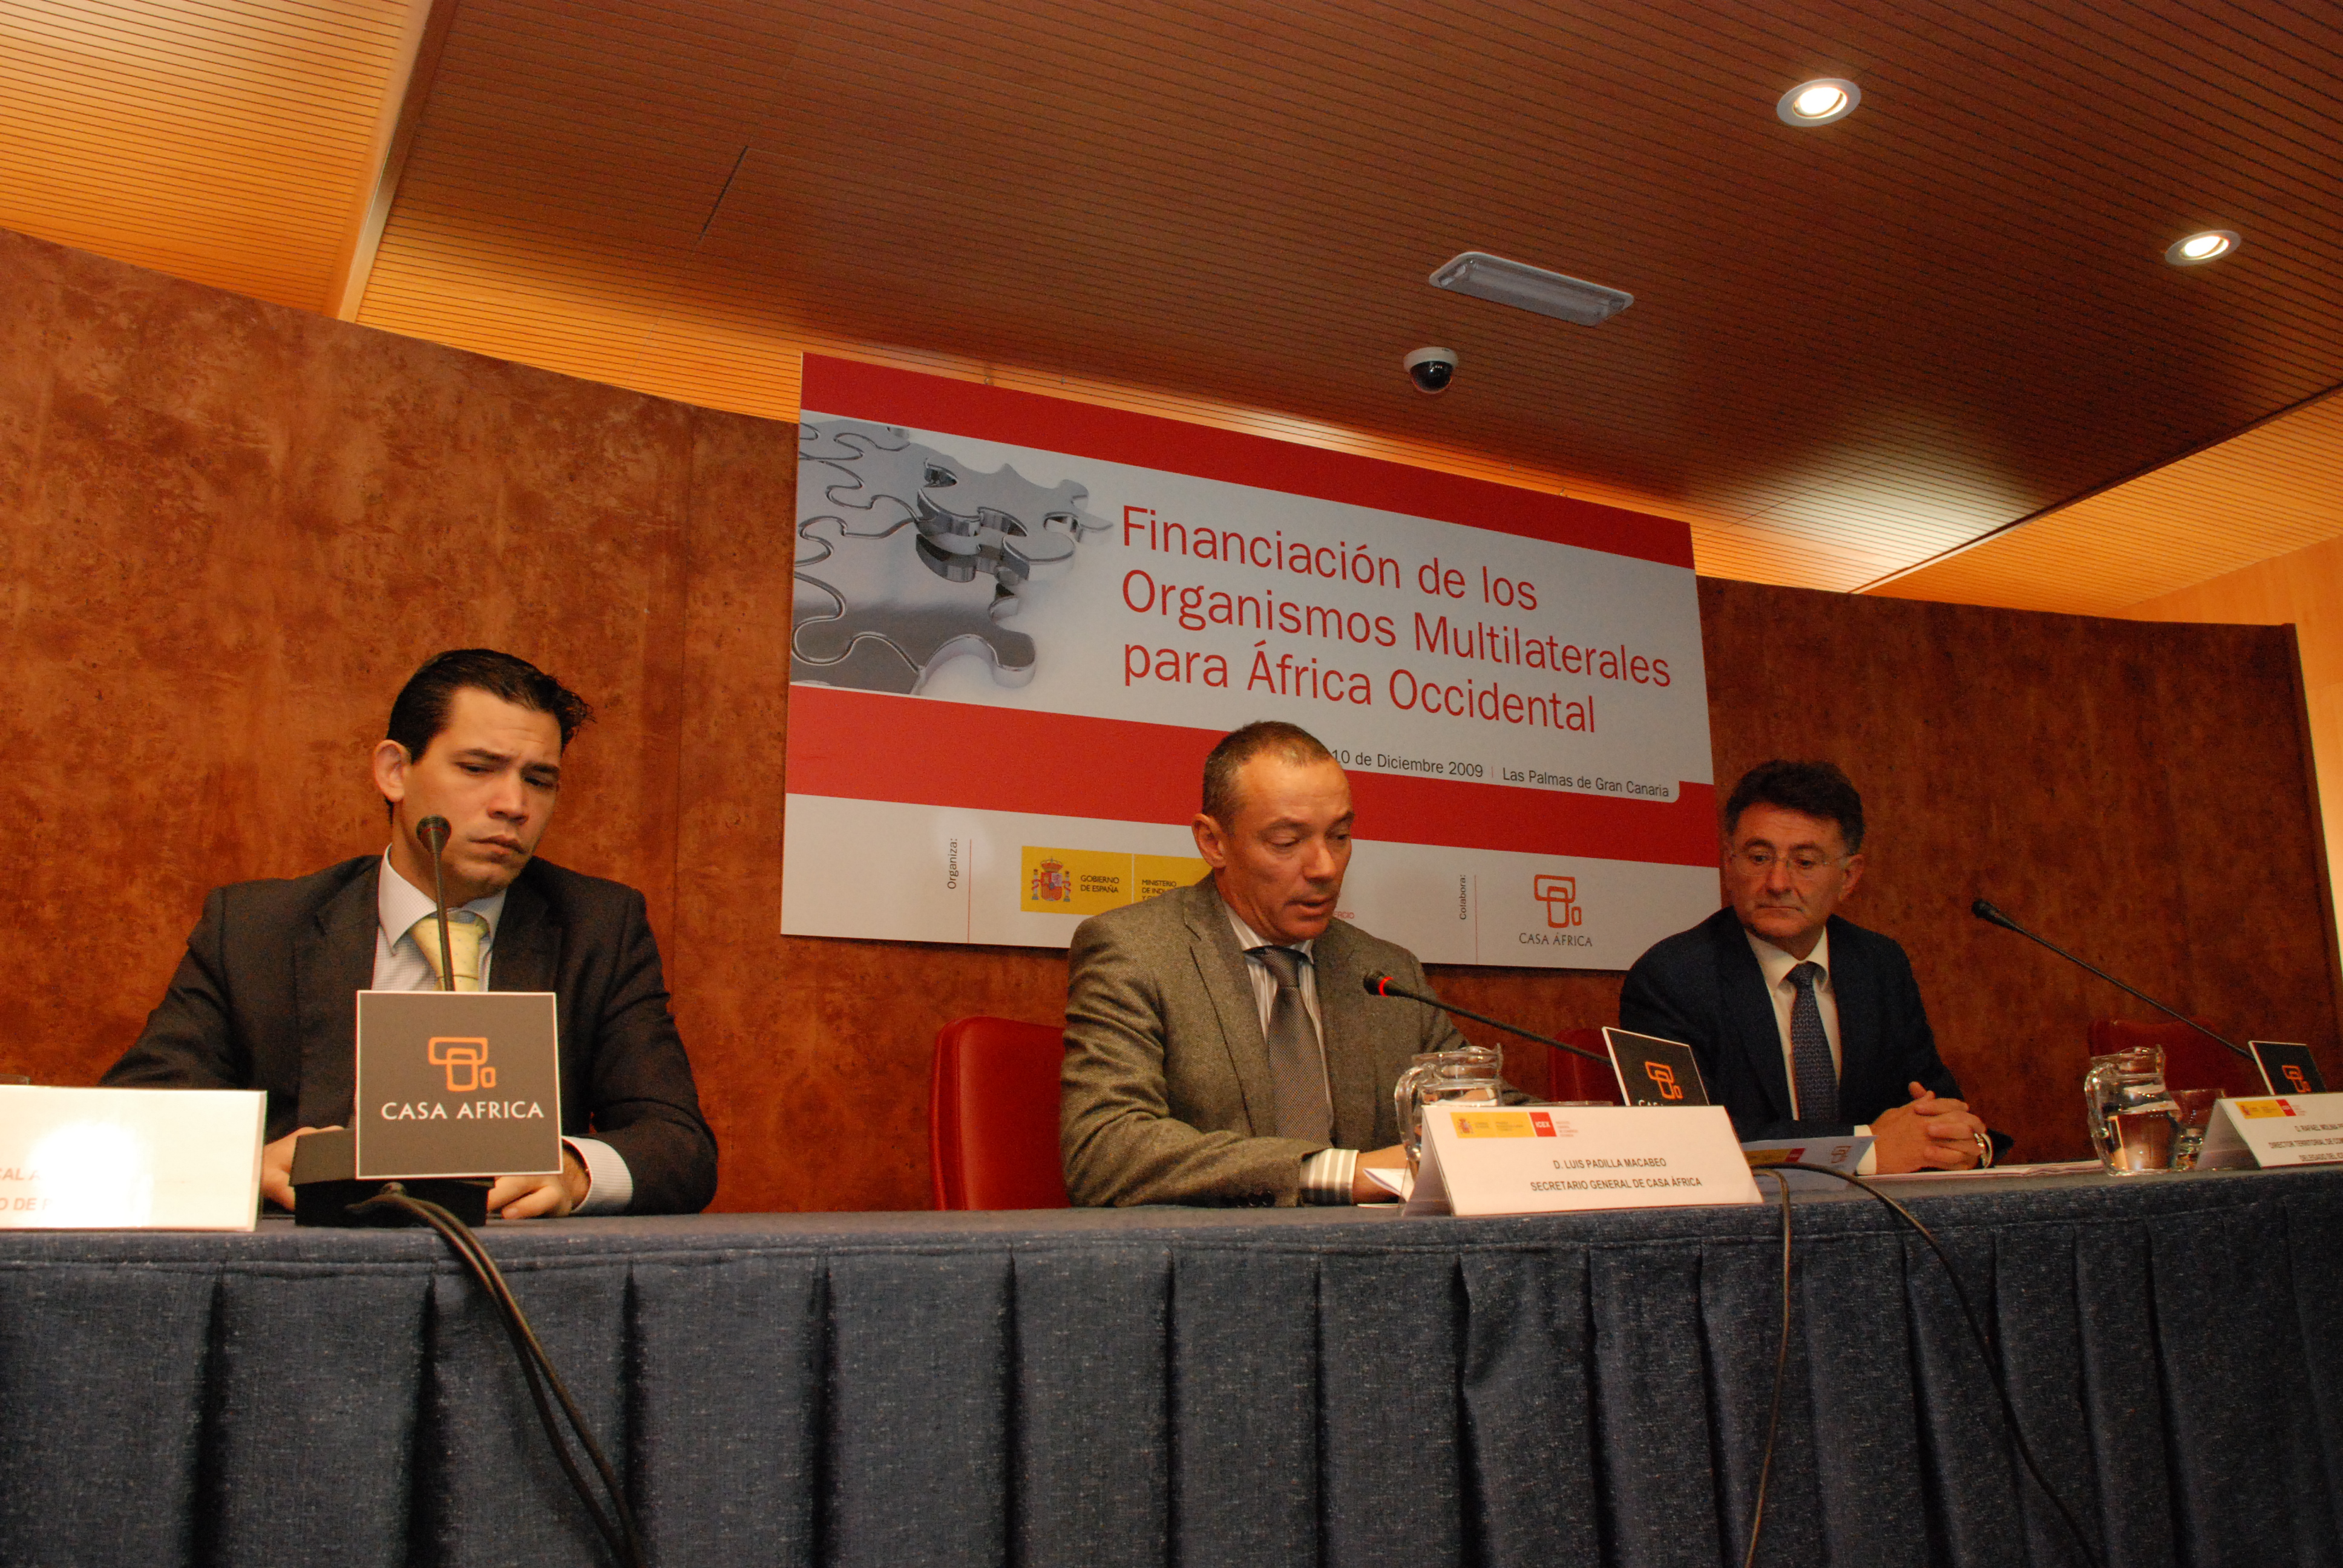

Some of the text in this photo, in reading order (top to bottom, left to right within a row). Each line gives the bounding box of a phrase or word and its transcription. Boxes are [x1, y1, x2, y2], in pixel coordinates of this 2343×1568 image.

[1123, 505, 1538, 610] Financiación de los
[1122, 569, 1671, 687] Organismos Multilaterales
[1125, 639, 1595, 733] para África Occidental
[1355, 752, 1372, 766] de
[1377, 753, 1444, 774] Diciembre
[1449, 761, 1483, 777] 2009
[1503, 767, 1524, 782] Las
[1529, 770, 1573, 787] Palmas
[1577, 776, 1591, 789] de
[1596, 777, 1622, 792] Gran
[1627, 781, 1669, 797] Canaria
[947, 838, 959, 889] Organiza:
[1080, 875, 1119, 884] GOBIERNO
[1142, 879, 1177, 887] MINISTERIO
[1092, 884, 1119, 893] ESPAÑA
[1519, 932, 1593, 947] CASA ÁFRICA
[381, 1101, 545, 1120] CASA AFRICA
[1553, 1157, 1666, 1169] D. LUIS PADILLA MACABEO
[1530, 1180, 1588, 1191] SECRETARIO
[1590, 1180, 1632, 1189] GENERAL
[1632, 1178, 1645, 1188] DE
[1646, 1178, 1670, 1187] CASA
